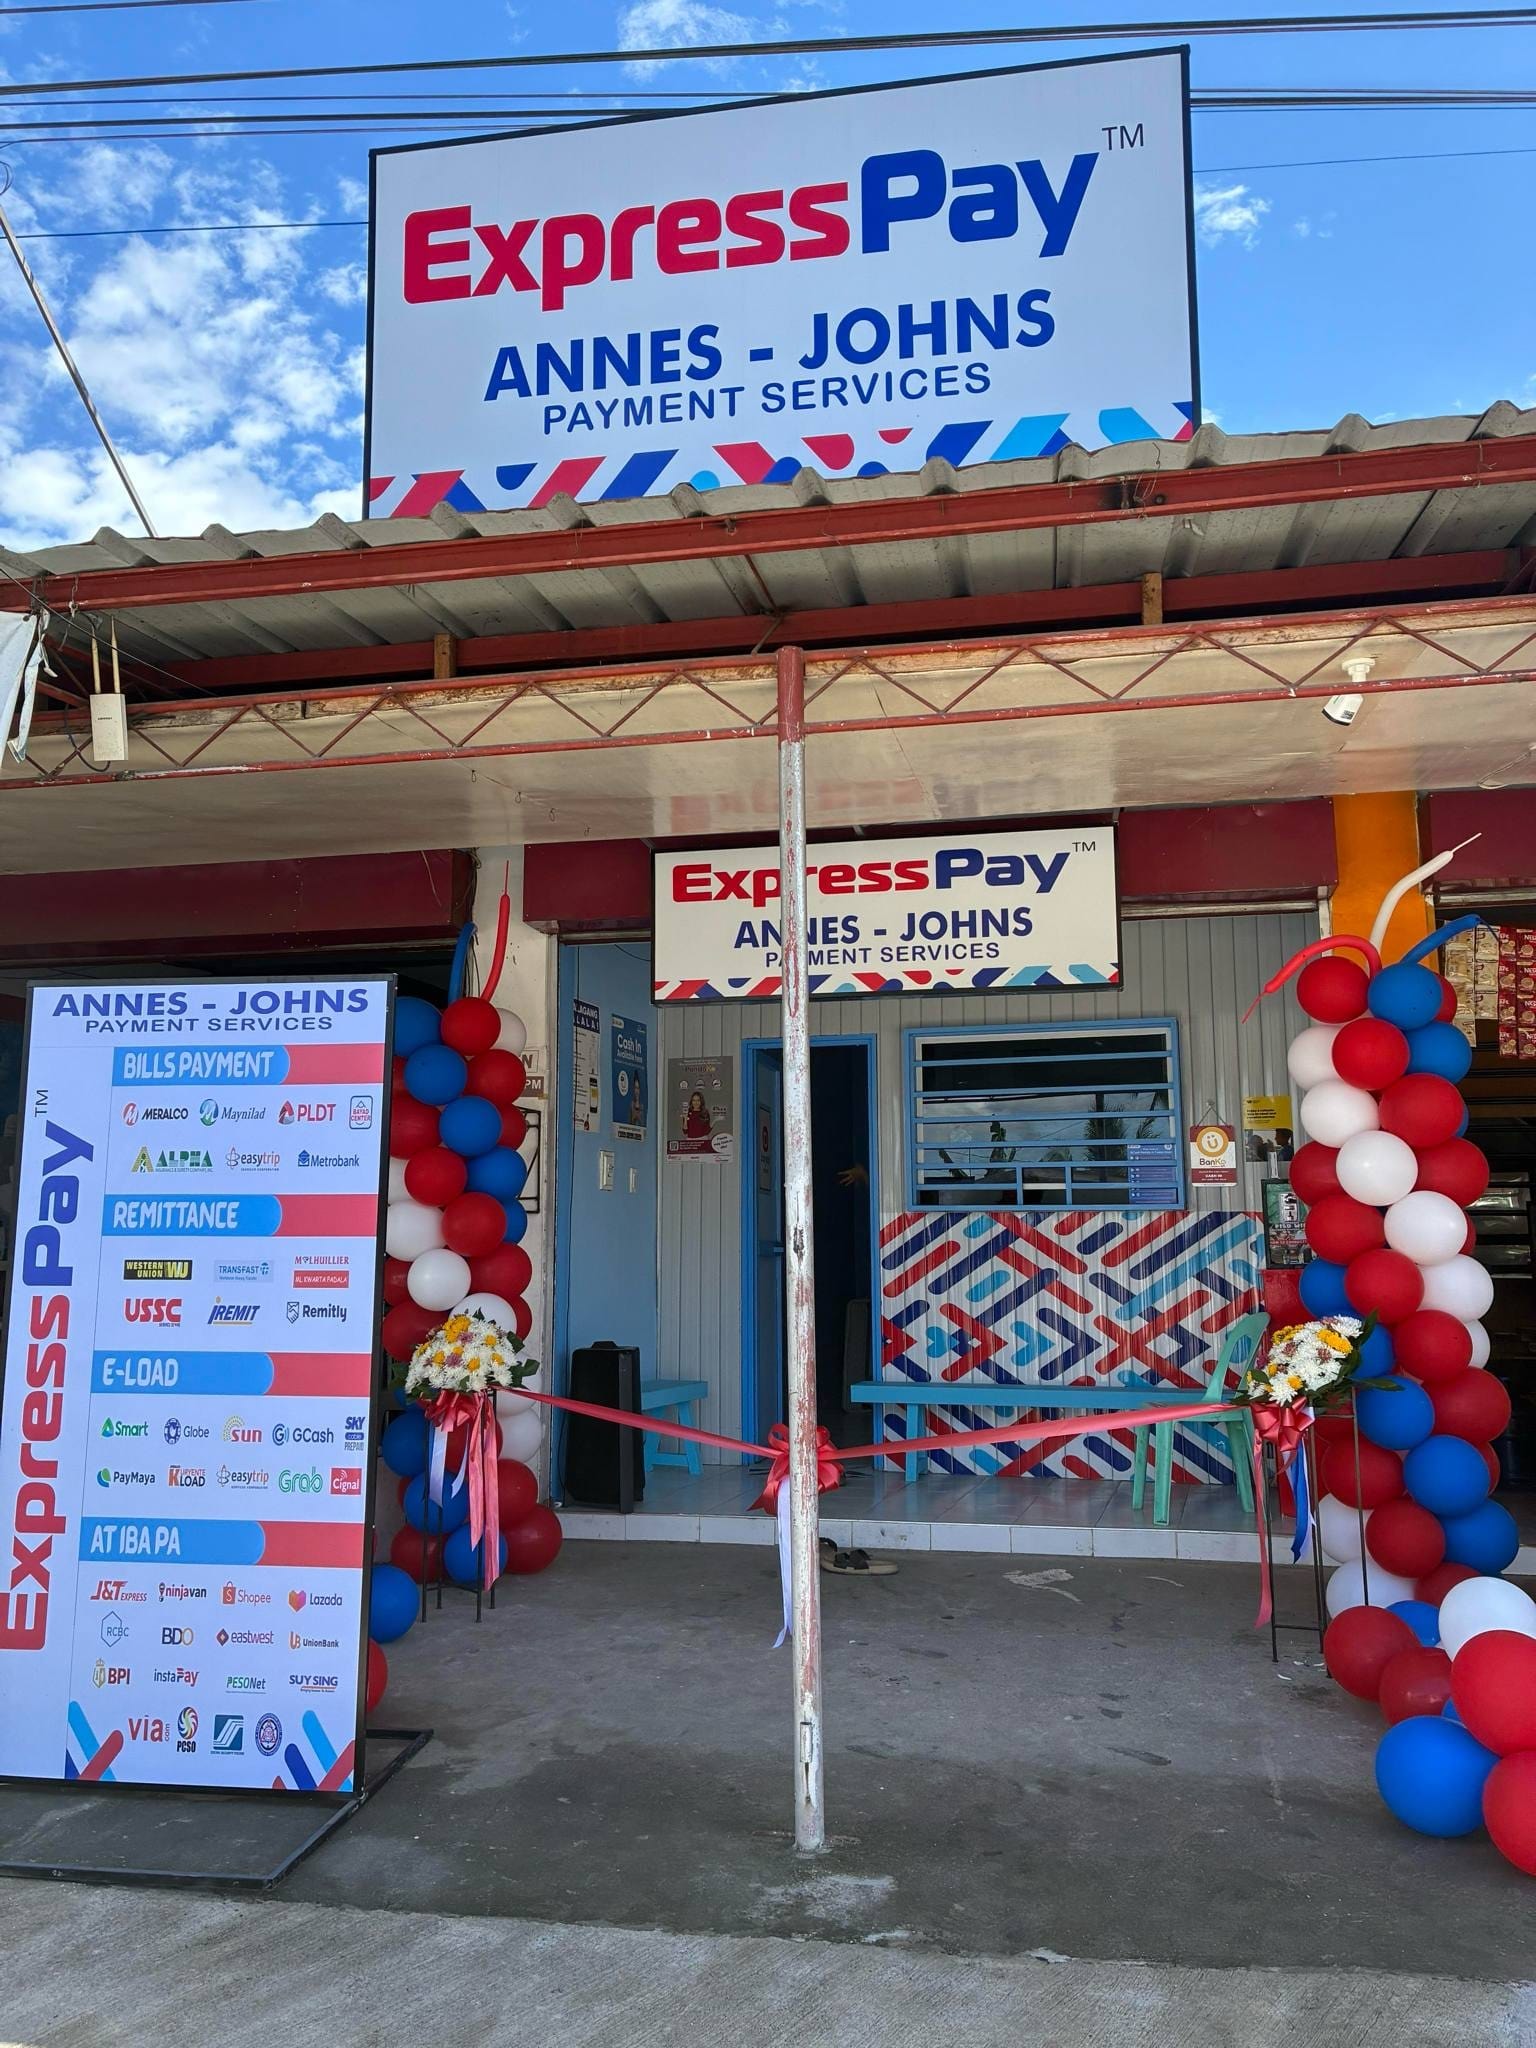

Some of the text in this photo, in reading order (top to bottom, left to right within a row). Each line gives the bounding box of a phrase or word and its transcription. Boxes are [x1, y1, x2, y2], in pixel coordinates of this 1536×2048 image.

[404, 123, 1145, 312] ExpressPay TM
[484, 288, 1055, 401] ANNES - JOHNS
[543, 362, 991, 435] PAYMENT SERVICES
[1072, 841, 1097, 853] TM
[900, 906, 1034, 941] JOHNS
[766, 942, 1000, 967] PMENT SERVICES
[52, 992, 188, 1017] ANNES
[229, 989, 369, 1014] JOHNS
[86, 1016, 332, 1033] PAYMENT SERVICES
[617, 1034, 634, 1053] Cash
[123, 1051, 275, 1079] BILLS PAYMENT
[141, 1106, 189, 1121] MERALCO
[220, 1105, 266, 1122] Maynilad
[297, 1103, 337, 1122] PLDT
[156, 1149, 213, 1168] ALPHA
[240, 1151, 280, 1167] easytrip
[310, 1153, 360, 1168] Metrobank
[113, 1200, 240, 1229] REMITTANCE
[125, 1261, 164, 1271] WESTERN
[136, 1270, 163, 1278] UNION
[218, 1264, 260, 1275] TRANSFAST
[124, 1298, 182, 1322] USSC
[302, 1303, 347, 1323] Remitly
[102, 1357, 179, 1387] E-LOAD
[0, 1120, 94, 1650] ExpressPay
[115, 1420, 149, 1437] Smart
[183, 1425, 210, 1439] Globe
[231, 1428, 262, 1443] sun
[292, 1427, 335, 1444] GCash
[344, 1441, 365, 1451] PREPAID
[113, 1471, 156, 1486] PayMaya
[180, 1475, 206, 1487] LOAD
[230, 1468, 269, 1485] easytrip
[278, 1466, 323, 1493] Grab
[332, 1478, 360, 1493] Cignal
[90, 1525, 181, 1556] AT IBA PA
[90, 1580, 147, 1602] J&T EXPRESS
[166, 1584, 207, 1601] ninjavan
[237, 1589, 272, 1606] Shopee
[309, 1593, 343, 1607] Lazada
[106, 1626, 129, 1638] RCBC
[162, 1627, 194, 1646] BDO
[230, 1630, 274, 1645] eastwest
[302, 1638, 339, 1649] UnionBank
[108, 1668, 131, 1685] BPI
[153, 1668, 200, 1687] instaPay
[226, 1676, 266, 1690] PESONet
[288, 1675, 339, 1687] SUY SING
[128, 1714, 164, 1742] via
[176, 1740, 197, 1753] PCSO
